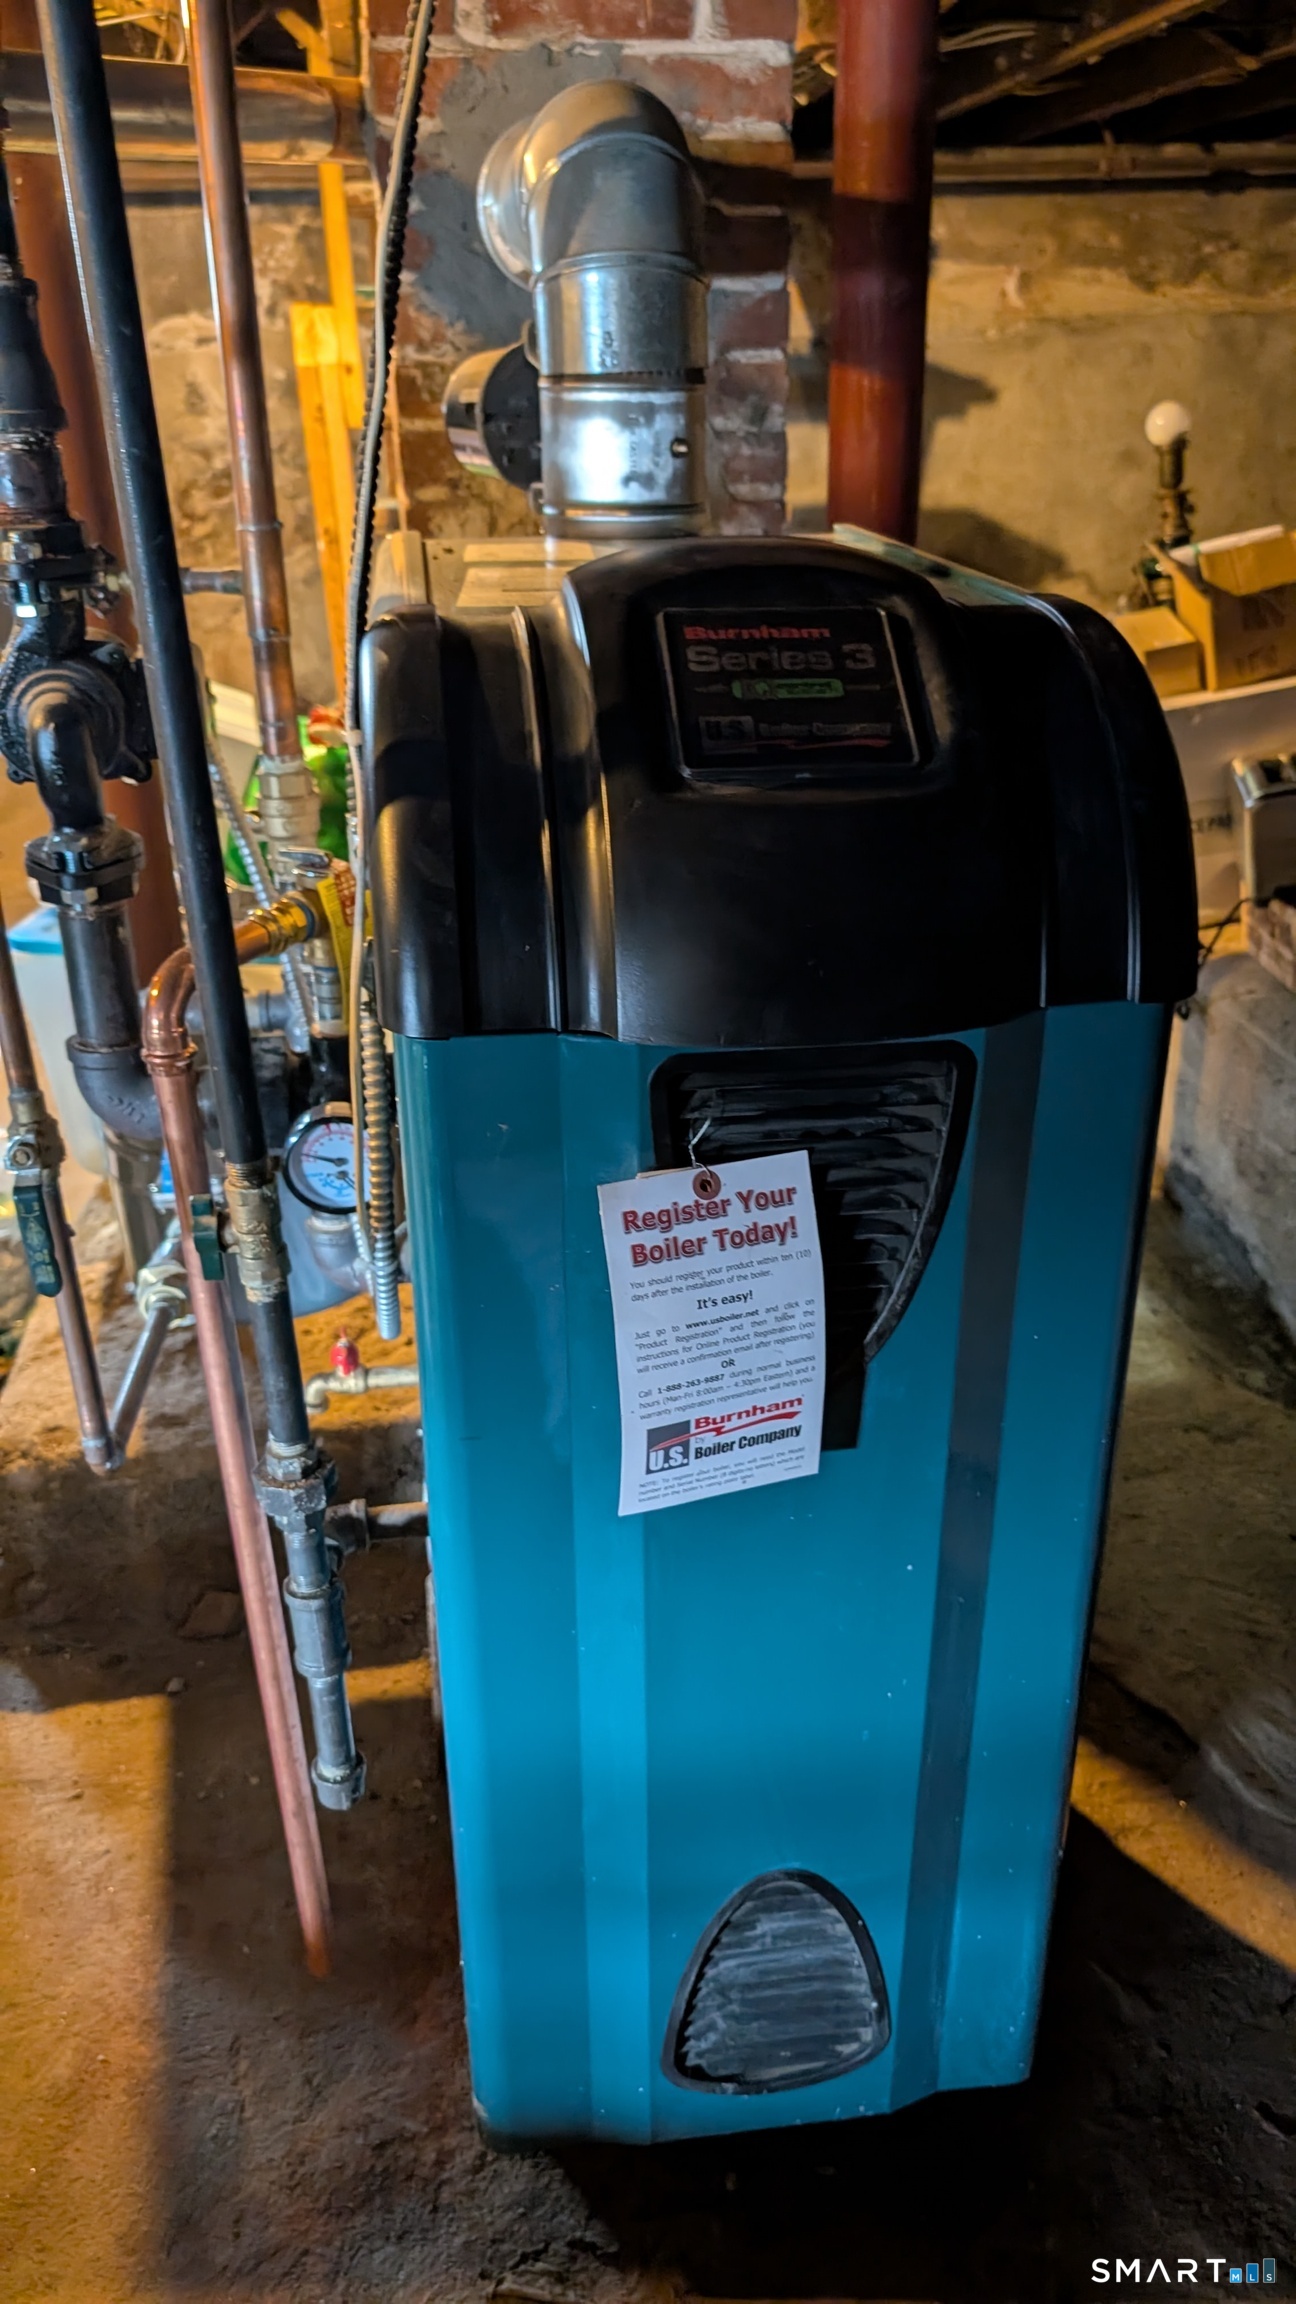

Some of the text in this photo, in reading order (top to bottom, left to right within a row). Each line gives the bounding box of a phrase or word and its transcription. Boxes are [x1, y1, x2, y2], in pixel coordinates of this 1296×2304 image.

[682, 623, 832, 641] Burnham
[685, 642, 877, 672] Series 3
[622, 1186, 798, 1234] Register Your
[630, 1216, 798, 1267] Boiler Today!
[629, 1248, 812, 1289] You should register your product within ten (10)
[631, 1292, 650, 1302] days
[651, 1288, 669, 1298] after
[670, 1286, 684, 1295] the
[685, 1278, 726, 1291] installation
[726, 1274, 735, 1284] of
[736, 1273, 749, 1282] the
[696, 1289, 754, 1310] It's easy!
[635, 1298, 815, 1340] Just go to www.usboiler.net and click on
[729, 1323, 744, 1332] and
[750, 1319, 768, 1328] then
[774, 1312, 796, 1323] follow
[802, 1309, 815, 1318] the
[636, 1348, 680, 1362] instructions
[682, 1345, 693, 1353] for
[695, 1340, 720, 1351] Online
[722, 1333, 751, 1344] Product
[753, 1324, 797, 1338] Registration
[637, 1365, 650, 1374] will
[651, 1359, 678, 1371] receive
[686, 1348, 732, 1364] confirmation
[733, 1343, 753, 1354] email
[755, 1340, 772, 1350] after
[638, 1389, 652, 1398] Call
[729, 1368, 753, 1379] during
[756, 1361, 782, 1372] normal
[785, 1354, 816, 1366] business
[721, 1357, 736, 1369] OR
[639, 1399, 660, 1409] hours
[795, 1365, 809, 1375] and
[639, 1408, 672, 1420] warranty
[674, 1398, 715, 1412] registration
[716, 1386, 768, 1402] representative
[769, 1382, 781, 1391] will
[782, 1378, 798, 1388] help
[694, 1397, 803, 1430] Burnham
[648, 1424, 802, 1471] U.S. Boiler Company
[694, 1436, 706, 1444] by
